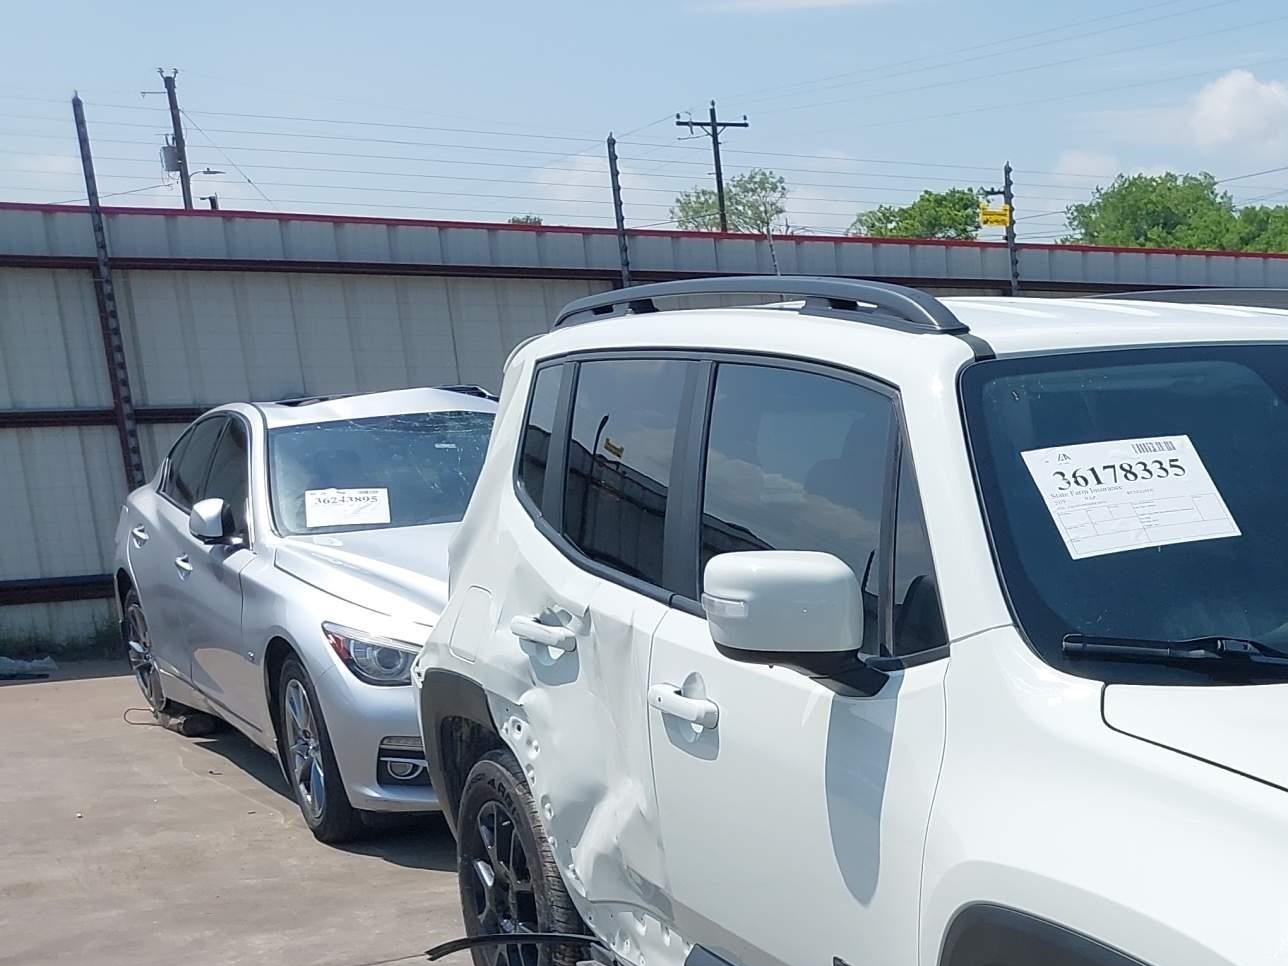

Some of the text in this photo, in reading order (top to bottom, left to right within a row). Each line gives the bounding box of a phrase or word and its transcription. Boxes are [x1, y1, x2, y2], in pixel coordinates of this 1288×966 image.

[1053, 458, 1186, 491] 36178335
[1070, 488, 1089, 496] Farm
[1089, 485, 1123, 494] Insurance
